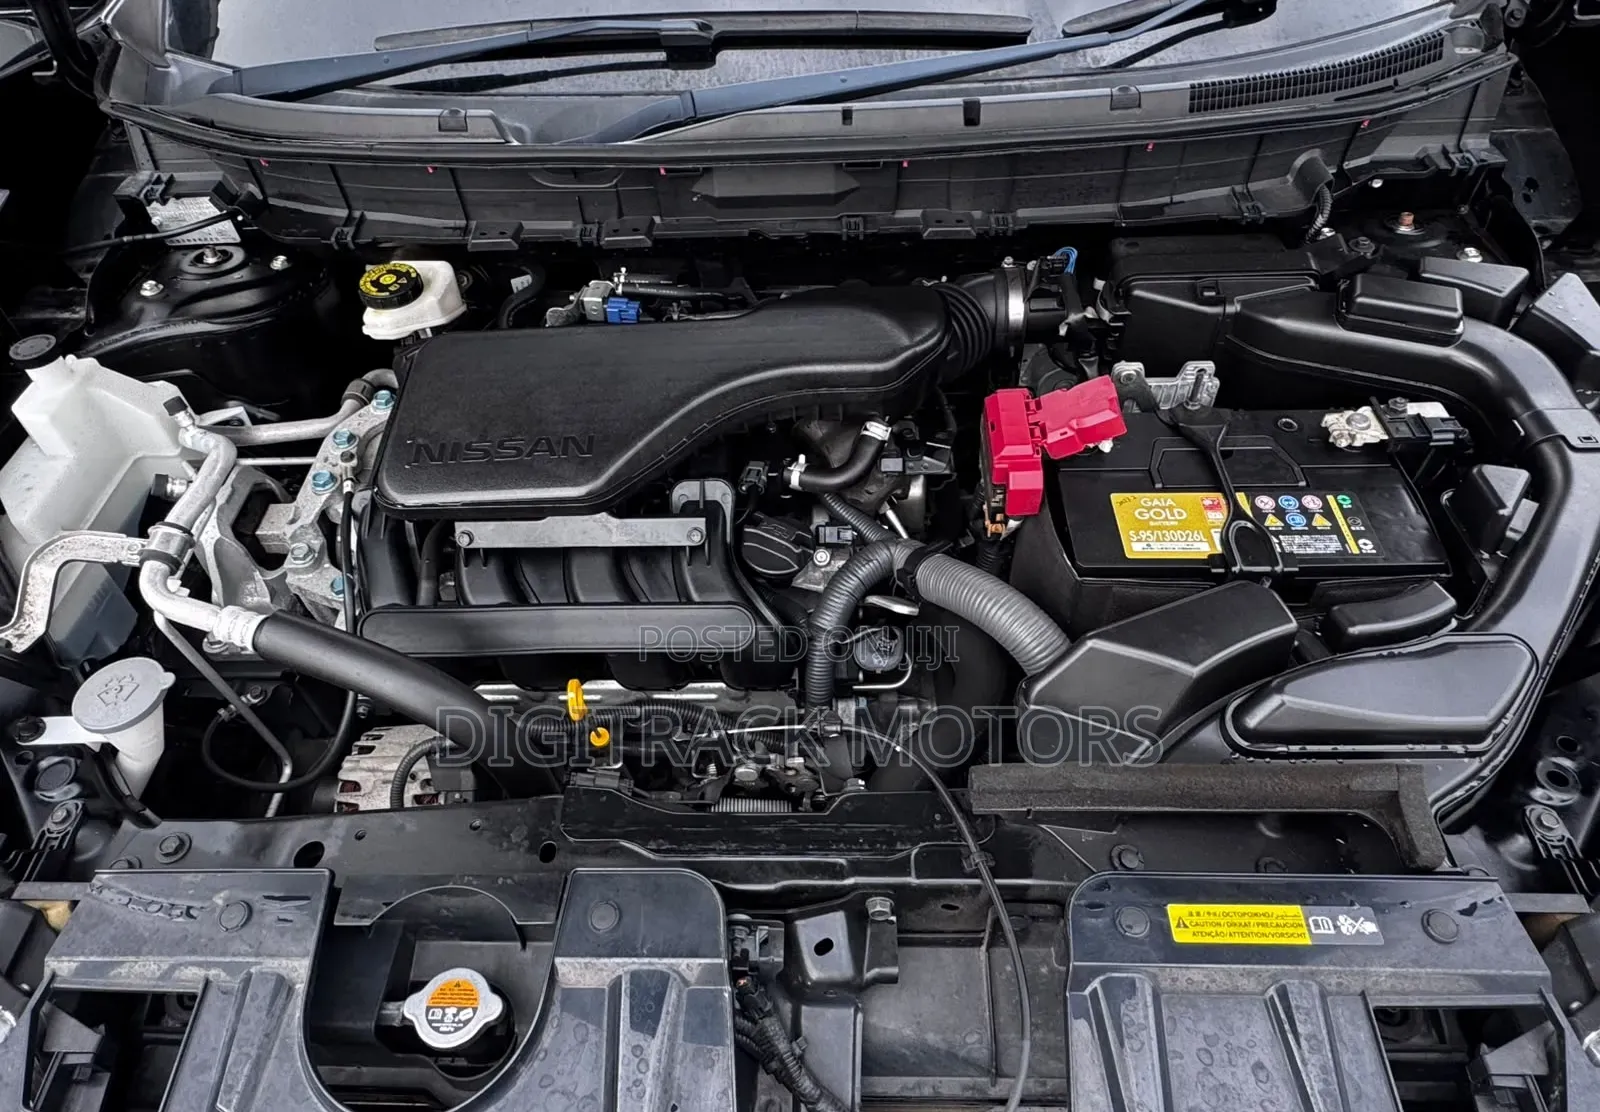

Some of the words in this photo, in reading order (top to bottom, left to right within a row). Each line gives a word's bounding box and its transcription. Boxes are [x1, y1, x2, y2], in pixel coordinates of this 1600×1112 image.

[410, 434, 596, 466] NISSAN
[1140, 497, 1177, 507] GAIA
[1134, 508, 1188, 520] GOLD
